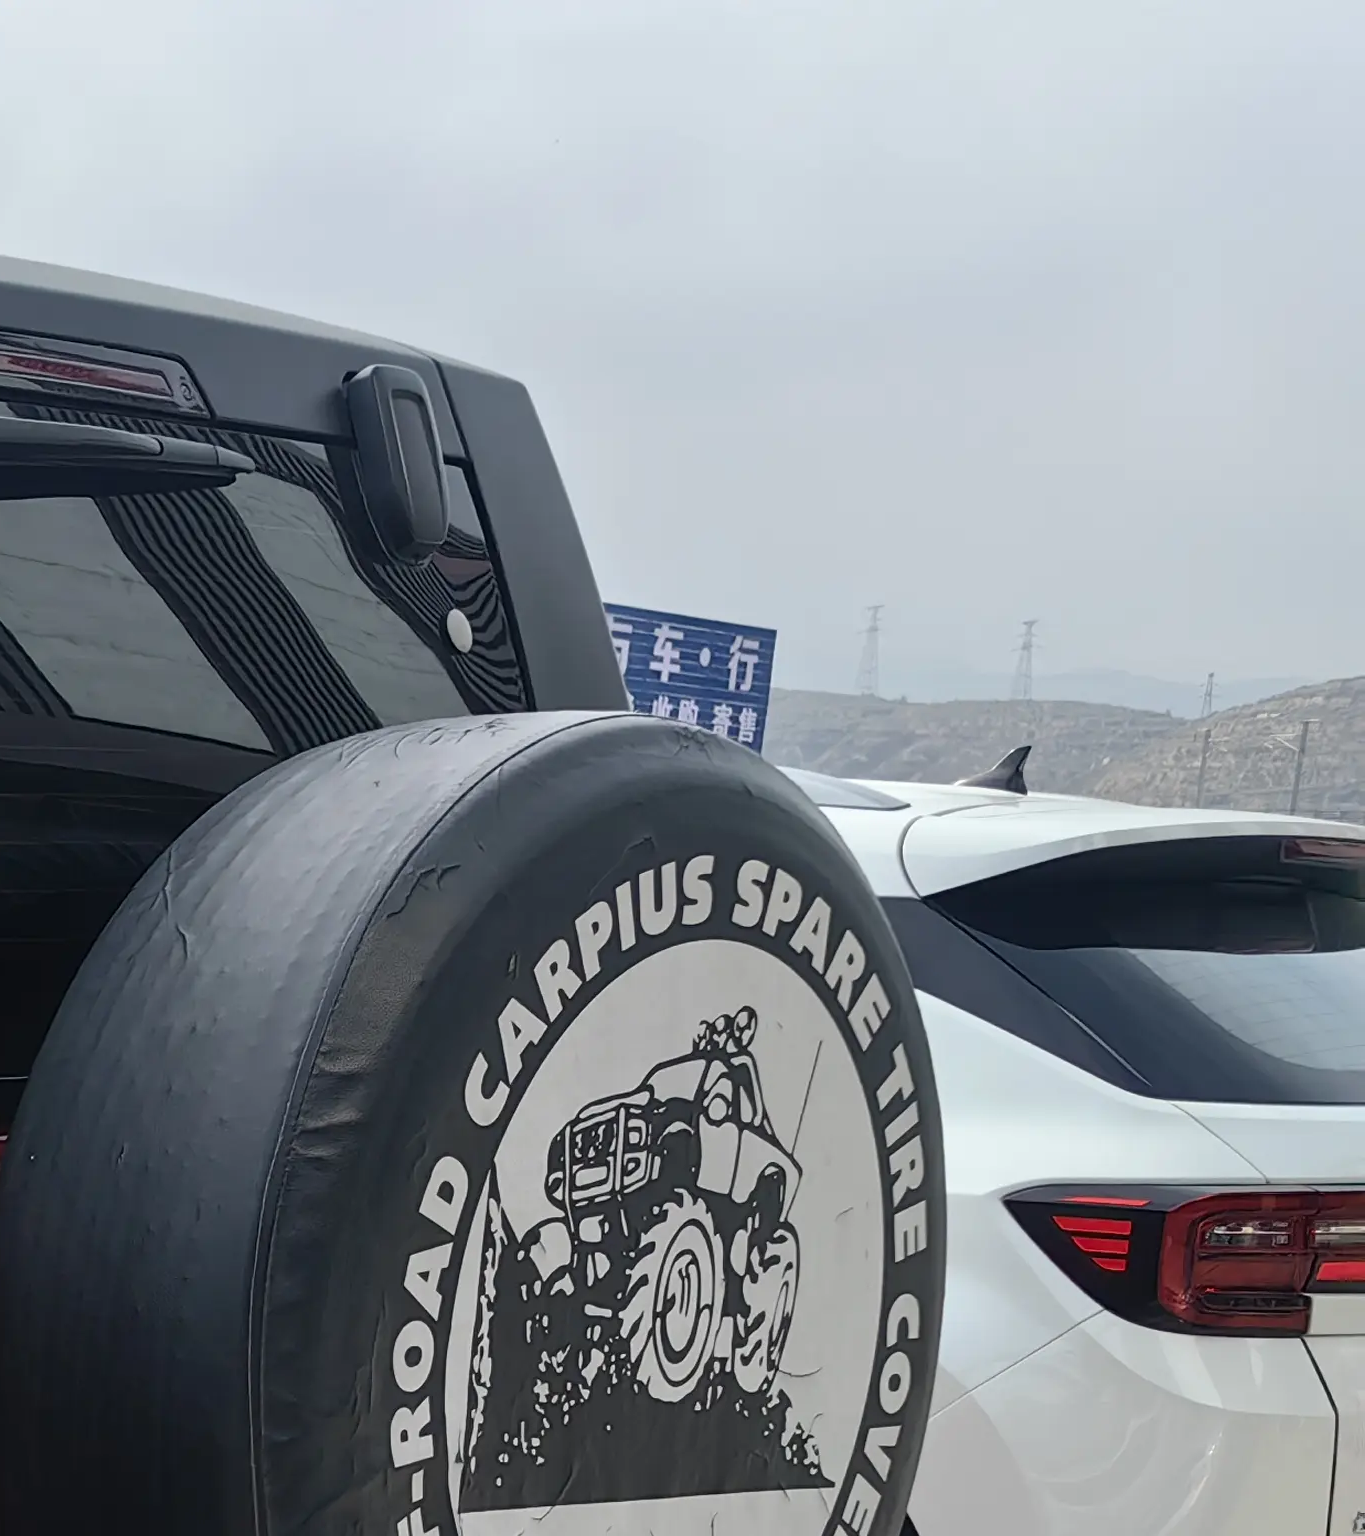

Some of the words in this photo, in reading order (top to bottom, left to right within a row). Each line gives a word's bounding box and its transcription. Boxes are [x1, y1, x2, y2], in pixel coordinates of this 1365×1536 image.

[463, 854, 715, 1127] CARPIUS
[732, 859, 891, 1053] SPARE
[874, 1041, 928, 1262] TIRE
